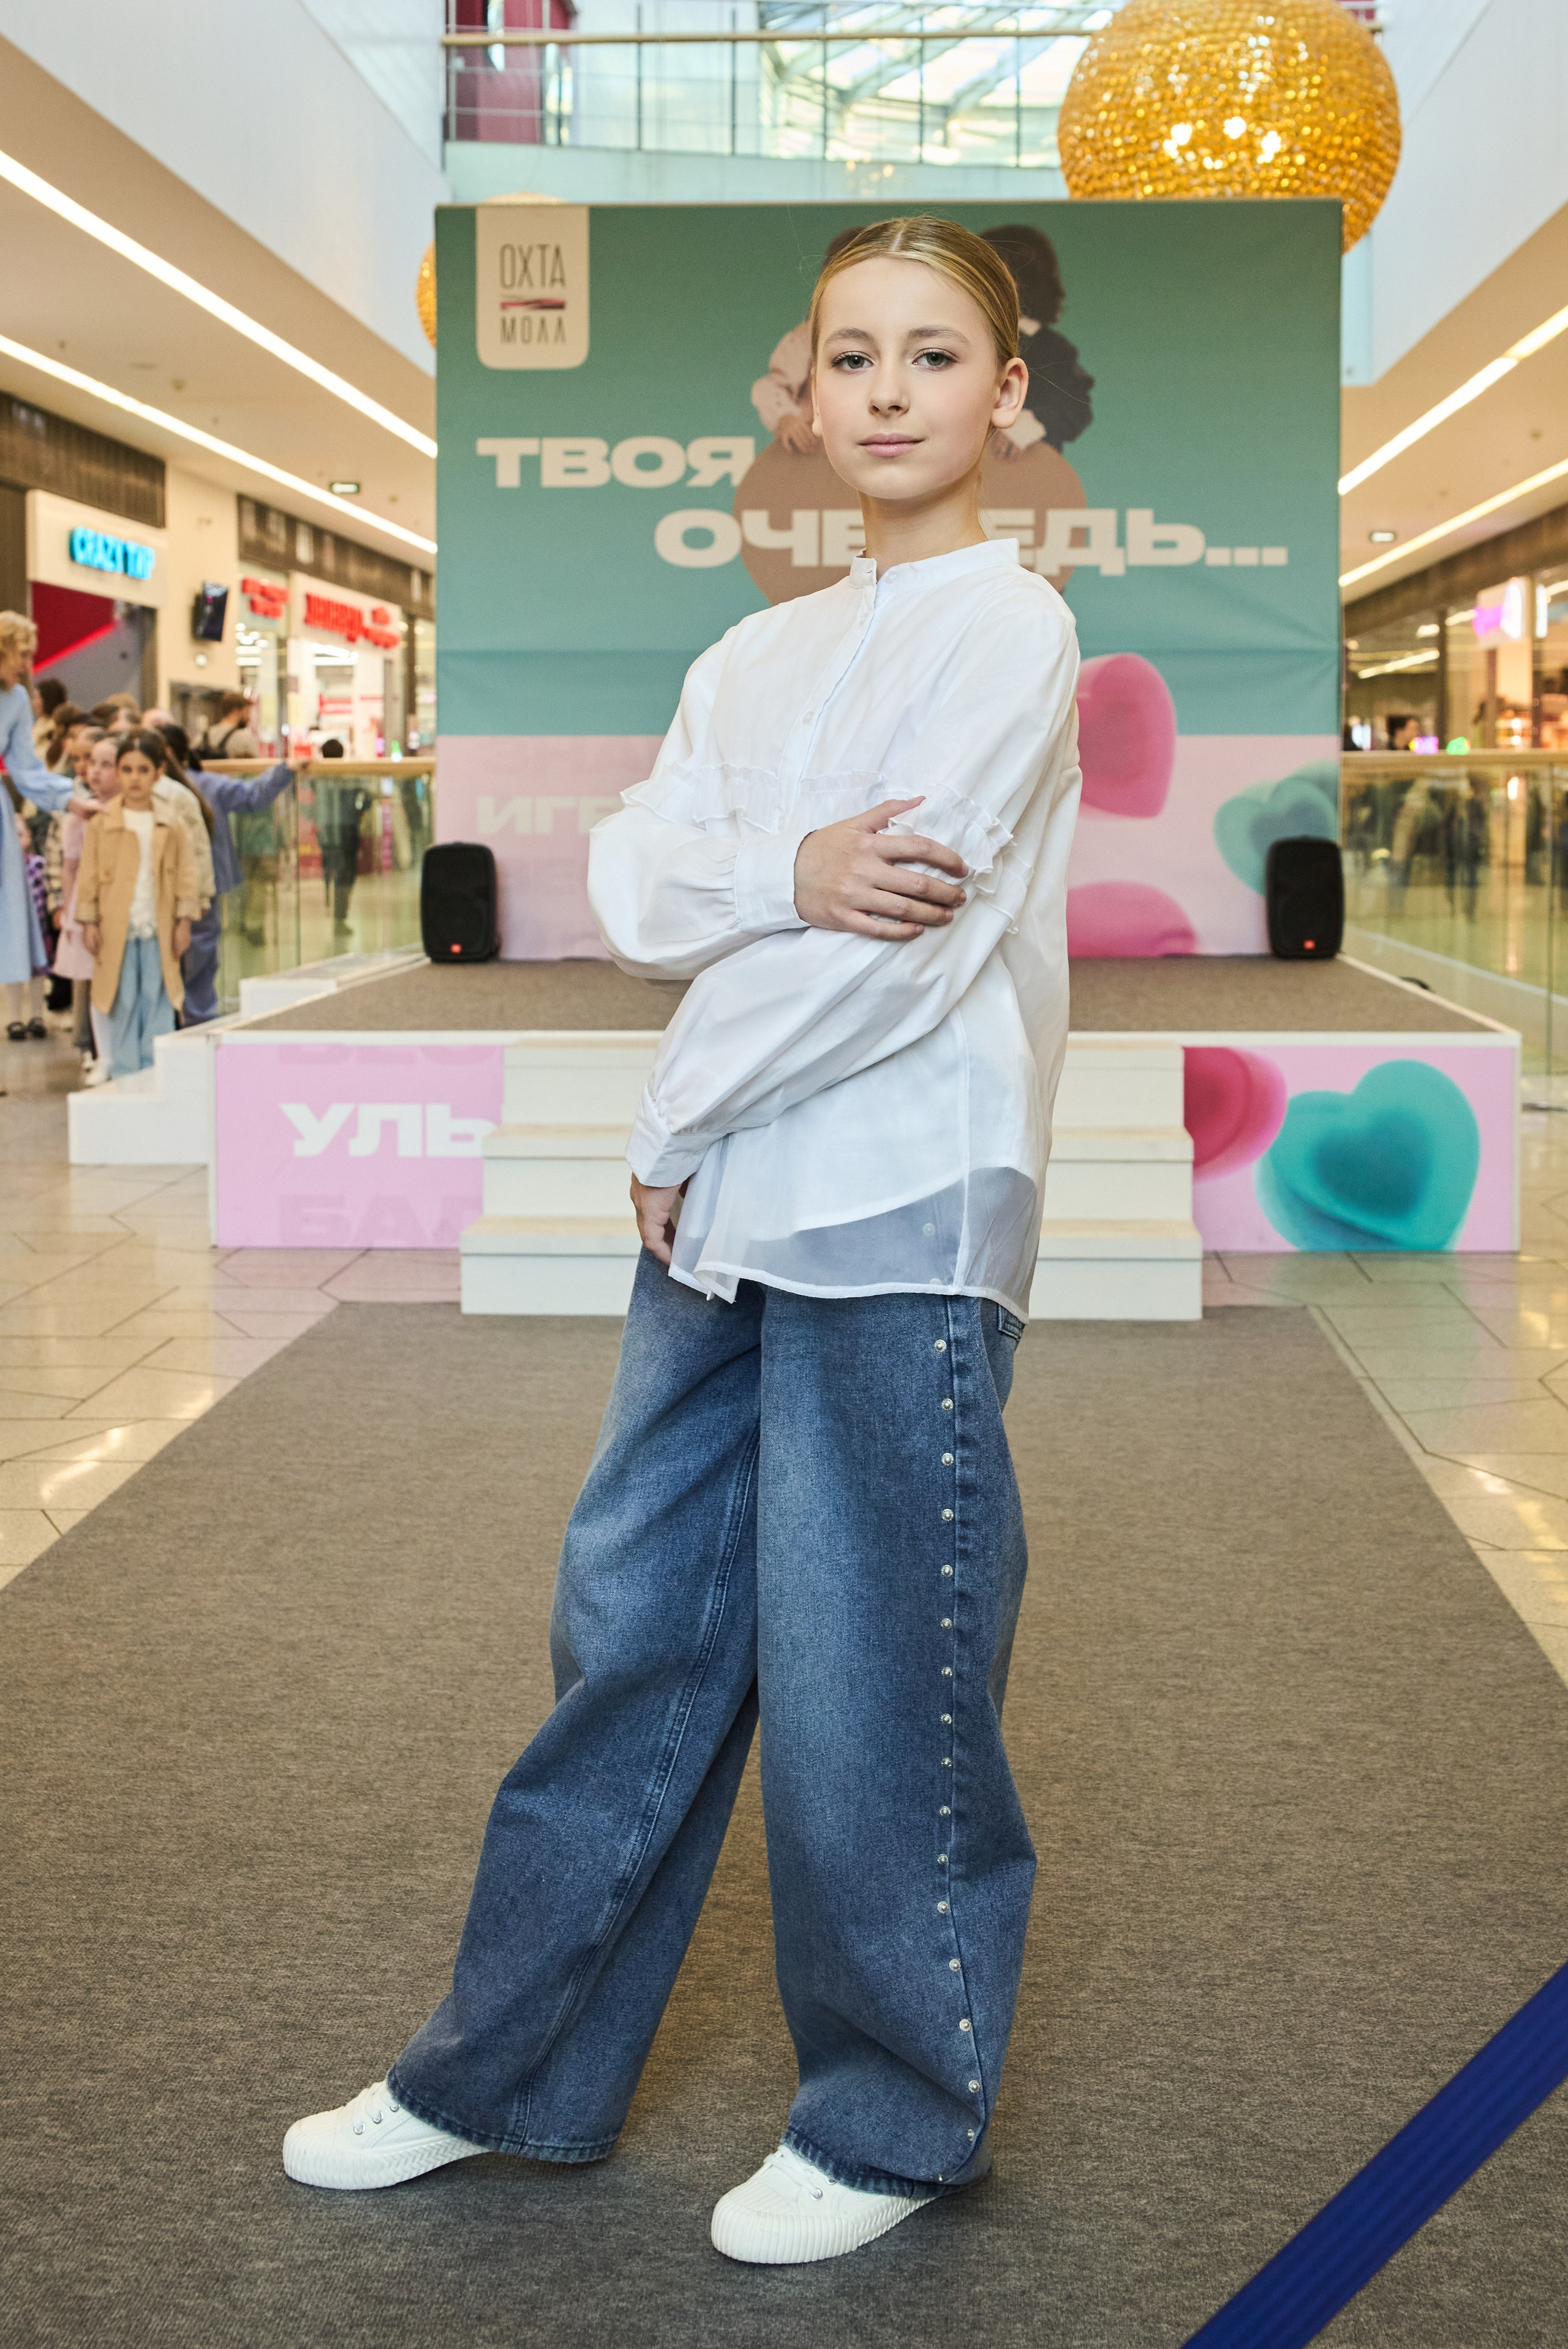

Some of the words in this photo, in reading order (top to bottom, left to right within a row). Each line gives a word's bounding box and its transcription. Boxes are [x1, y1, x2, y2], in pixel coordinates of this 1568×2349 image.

[499, 244, 566, 289] ОХТА
[500, 315, 566, 344] МОЛЛ
[476, 435, 756, 488] ТВОЯ
